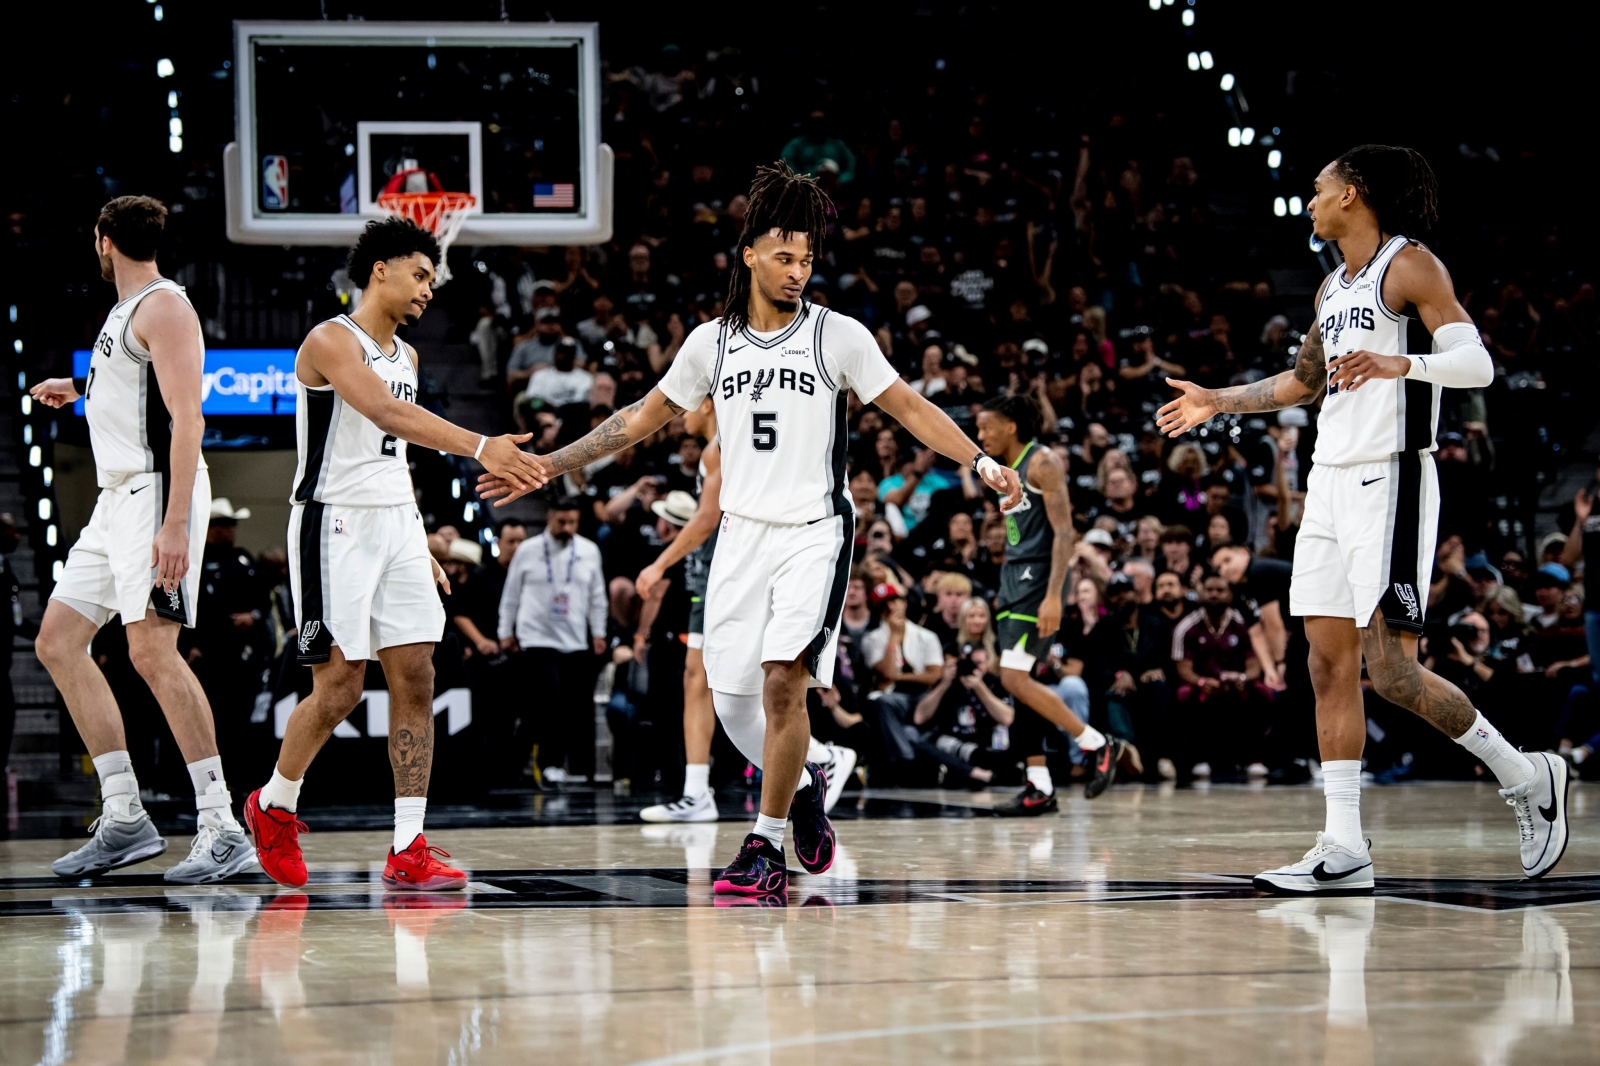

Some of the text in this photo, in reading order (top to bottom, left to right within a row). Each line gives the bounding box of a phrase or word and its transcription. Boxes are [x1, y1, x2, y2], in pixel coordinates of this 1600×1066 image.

[1320, 307, 1375, 347] SPURS
[202, 364, 297, 403] yCapita
[722, 368, 815, 403] SPURS
[751, 411, 778, 452] 5
